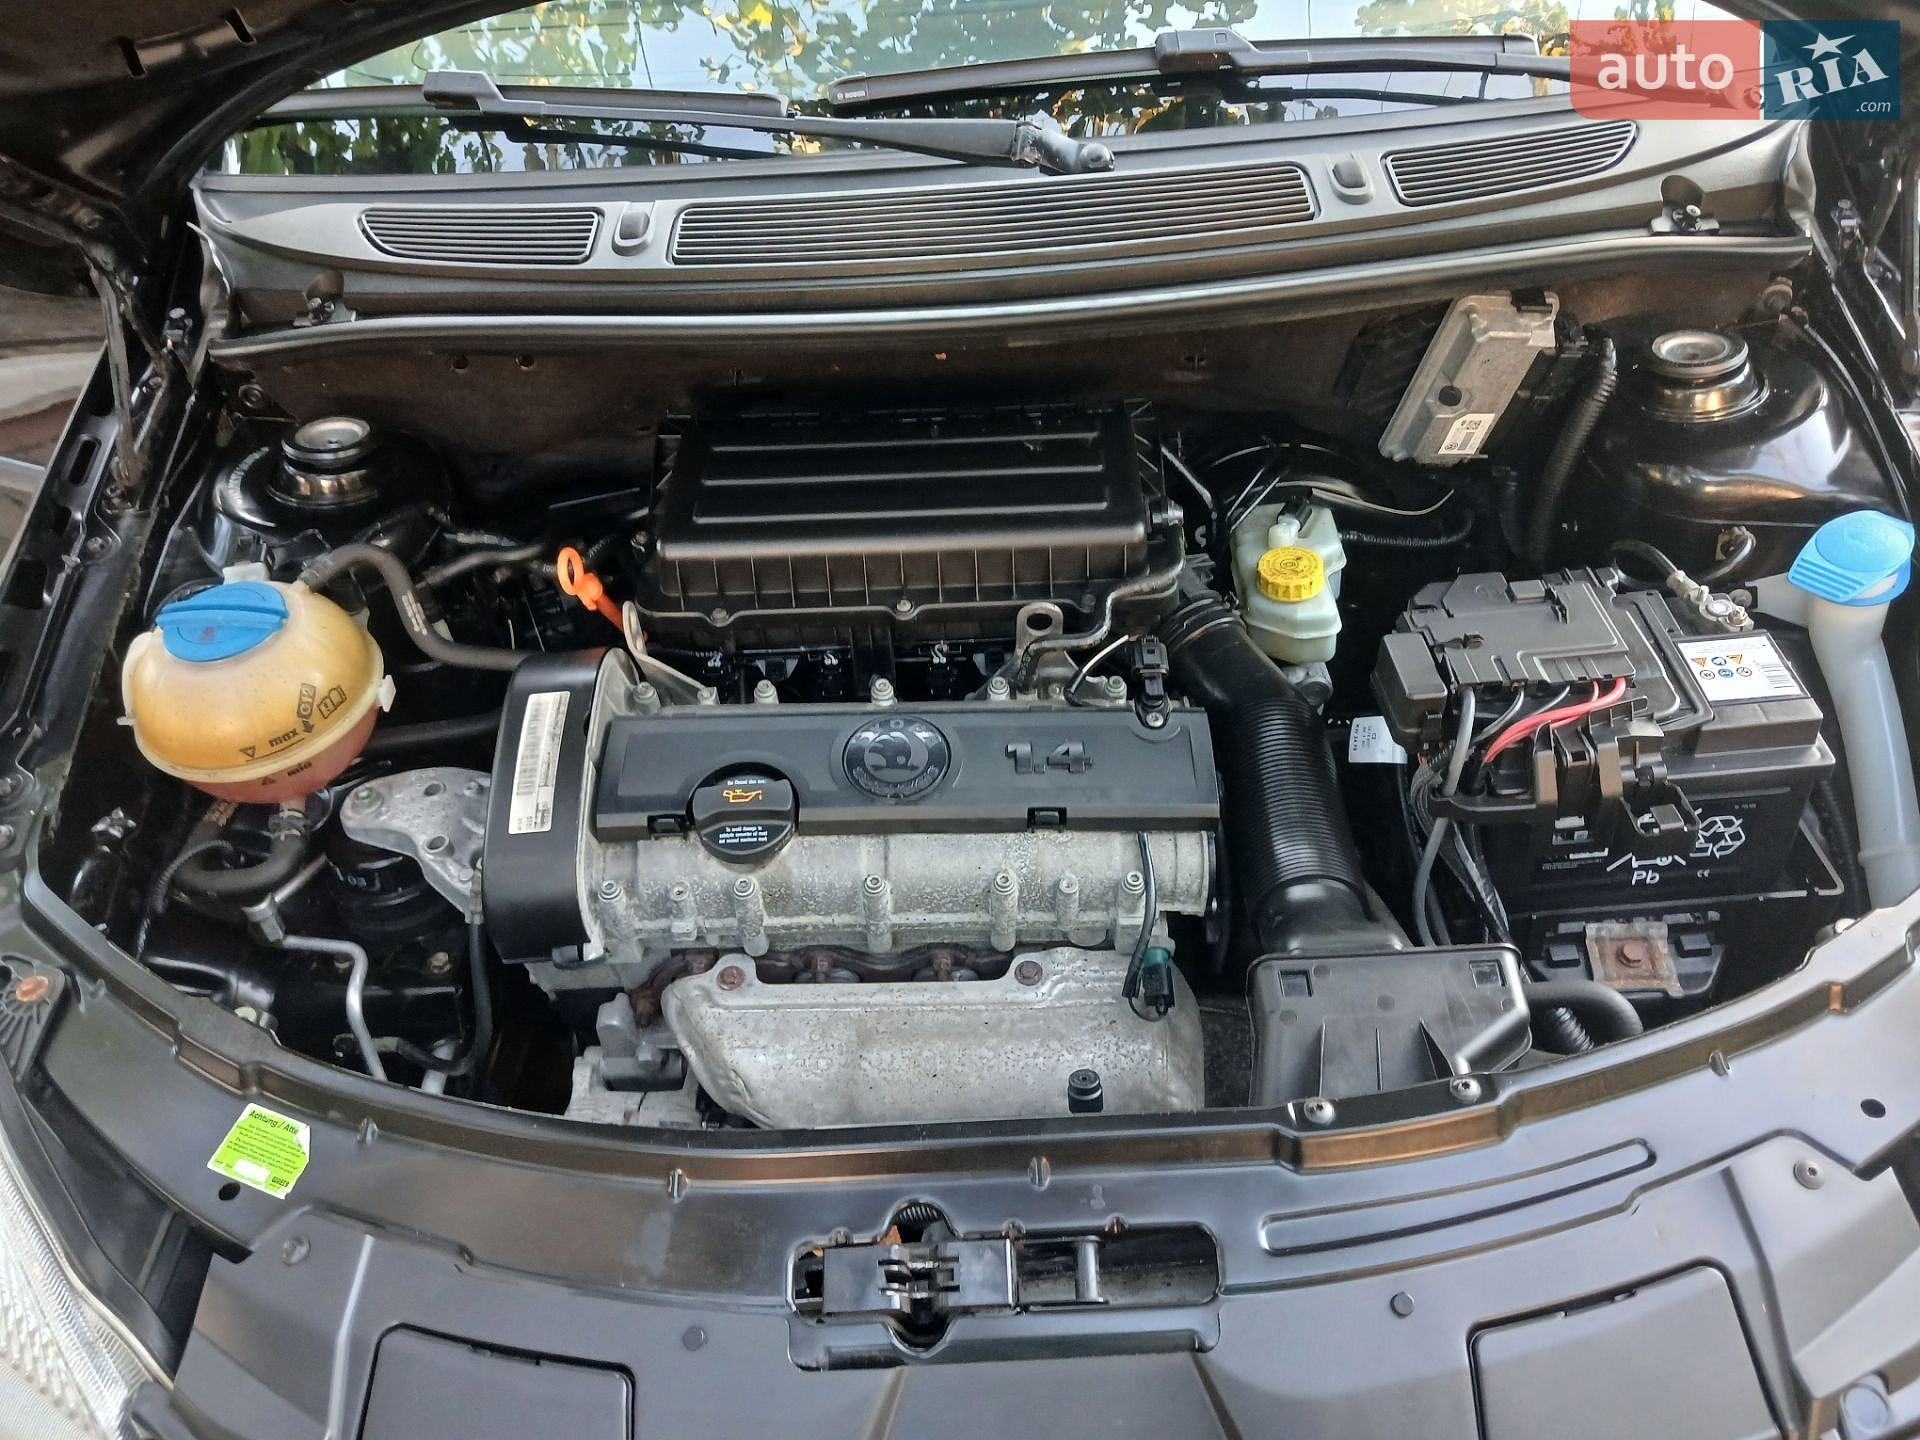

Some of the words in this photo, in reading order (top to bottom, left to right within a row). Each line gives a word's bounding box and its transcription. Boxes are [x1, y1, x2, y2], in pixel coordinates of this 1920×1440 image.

[268, 728, 299, 748] max
[1004, 740, 1094, 775] 1.4
[1632, 870, 1660, 886] Pb
[249, 1110, 278, 1128] Achtung
